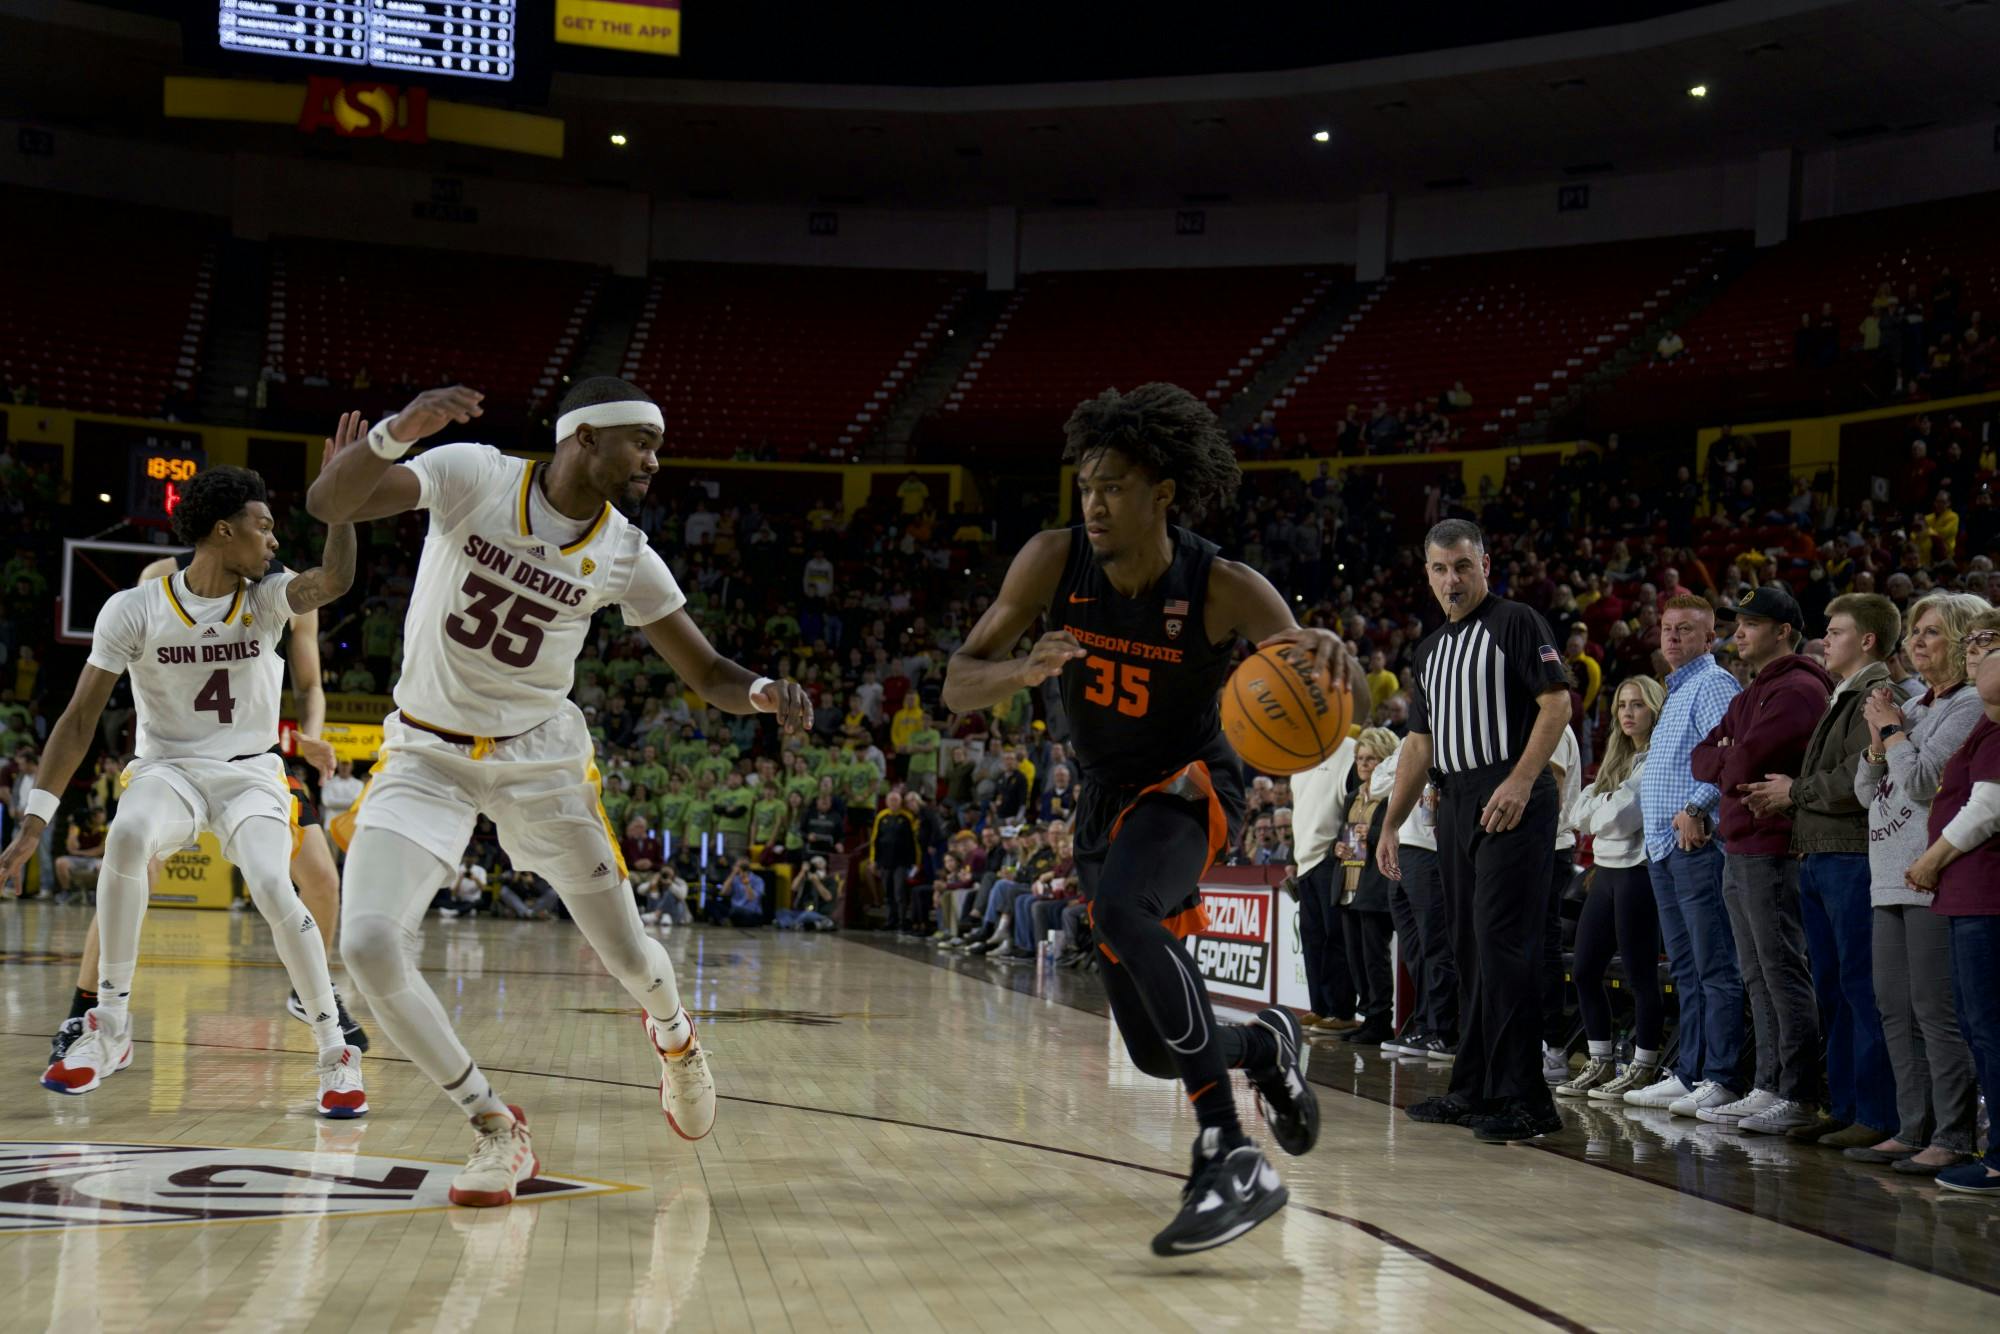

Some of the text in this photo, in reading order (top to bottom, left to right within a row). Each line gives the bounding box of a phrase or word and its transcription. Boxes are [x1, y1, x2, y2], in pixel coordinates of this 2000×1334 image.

[562, 16, 672, 38] GET THE APP
[298, 75, 427, 143] ASU
[147, 457, 197, 480] 18:50
[463, 534, 587, 607] SUN DEVILS
[445, 571, 559, 668] 35
[157, 640, 260, 664] SUN DEVILS
[1131, 642, 1184, 663] STATE
[194, 668, 236, 723] 4
[1085, 655, 1150, 718] 35
[1871, 806, 1913, 841] DEVILS
[1200, 895, 1260, 937] RIZONA
[1197, 939, 1263, 985] SPORTS
